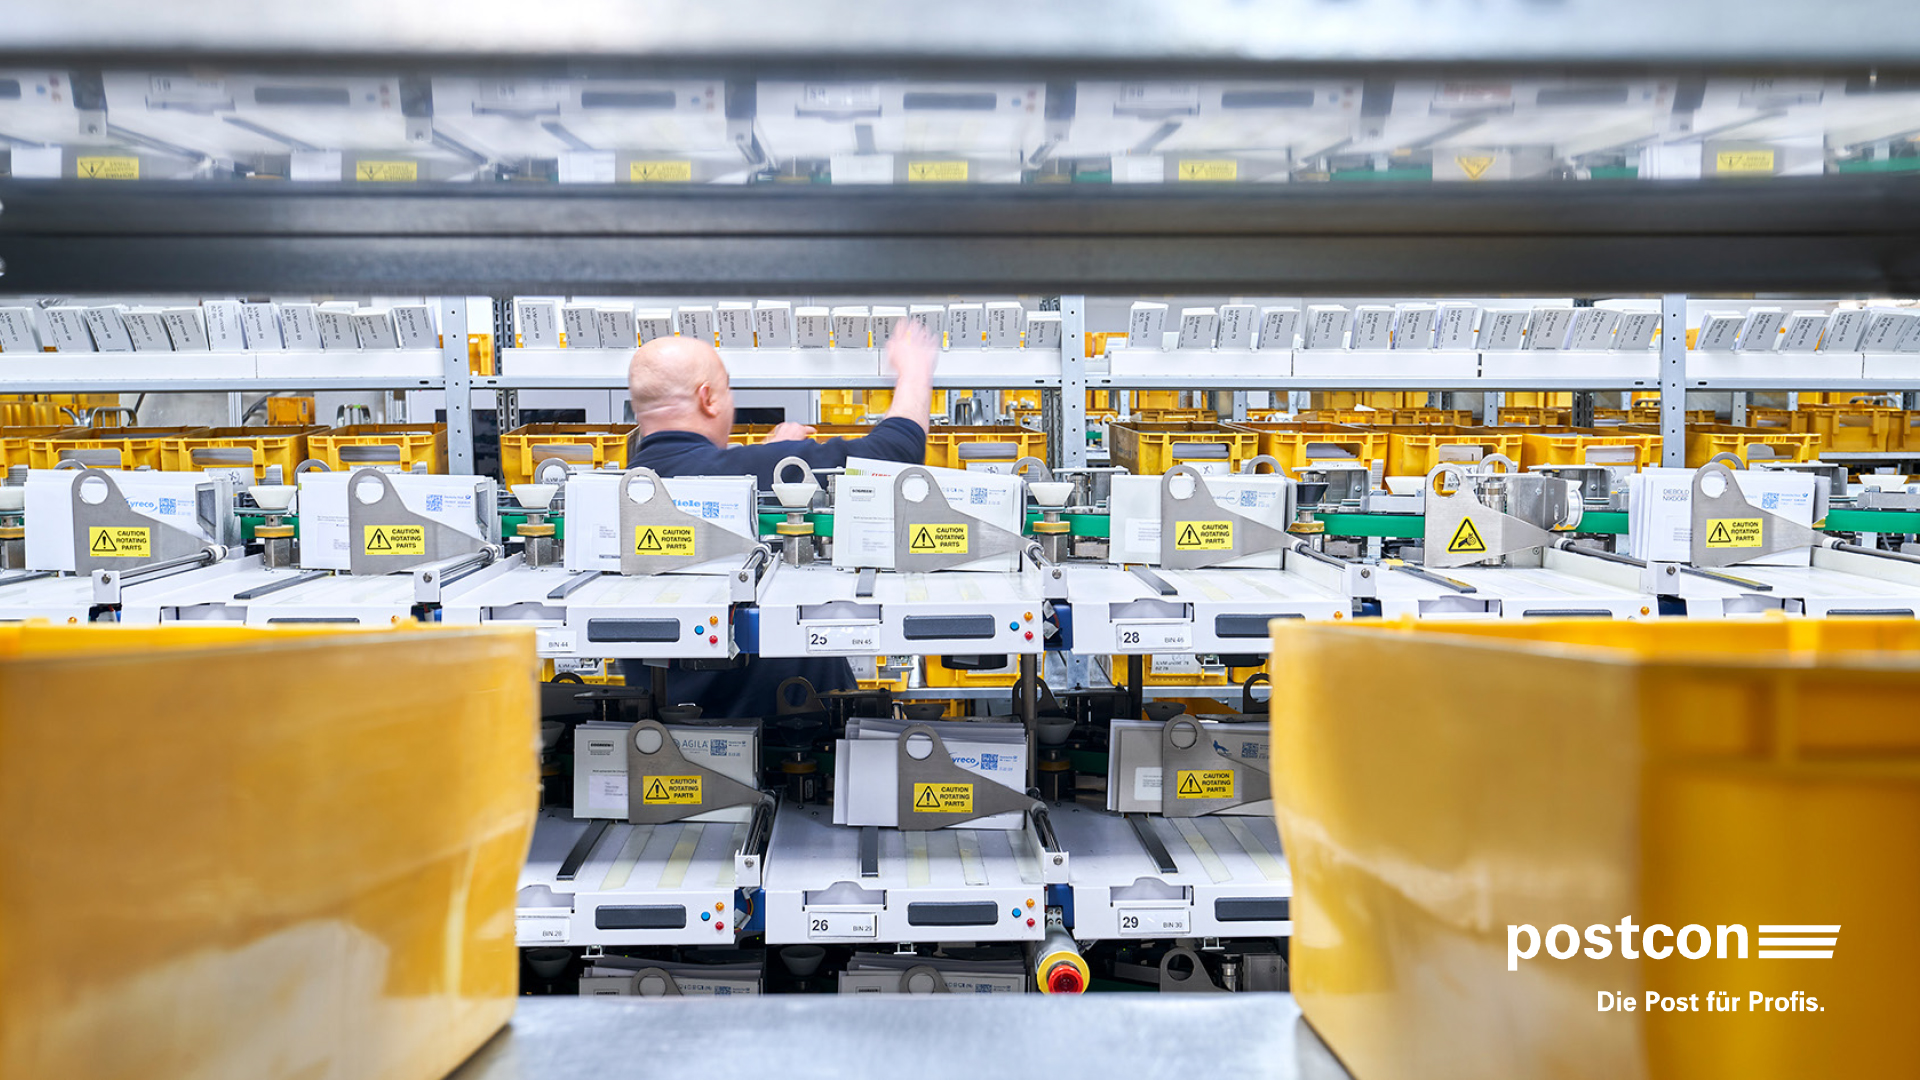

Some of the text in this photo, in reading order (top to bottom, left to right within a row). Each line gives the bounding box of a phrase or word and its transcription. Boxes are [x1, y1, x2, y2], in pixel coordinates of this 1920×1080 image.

[810, 633, 828, 645] 25
[1123, 631, 1140, 644] 28
[682, 740, 709, 748] AGILA
[812, 919, 829, 931] 26
[1122, 916, 1139, 928] 29
